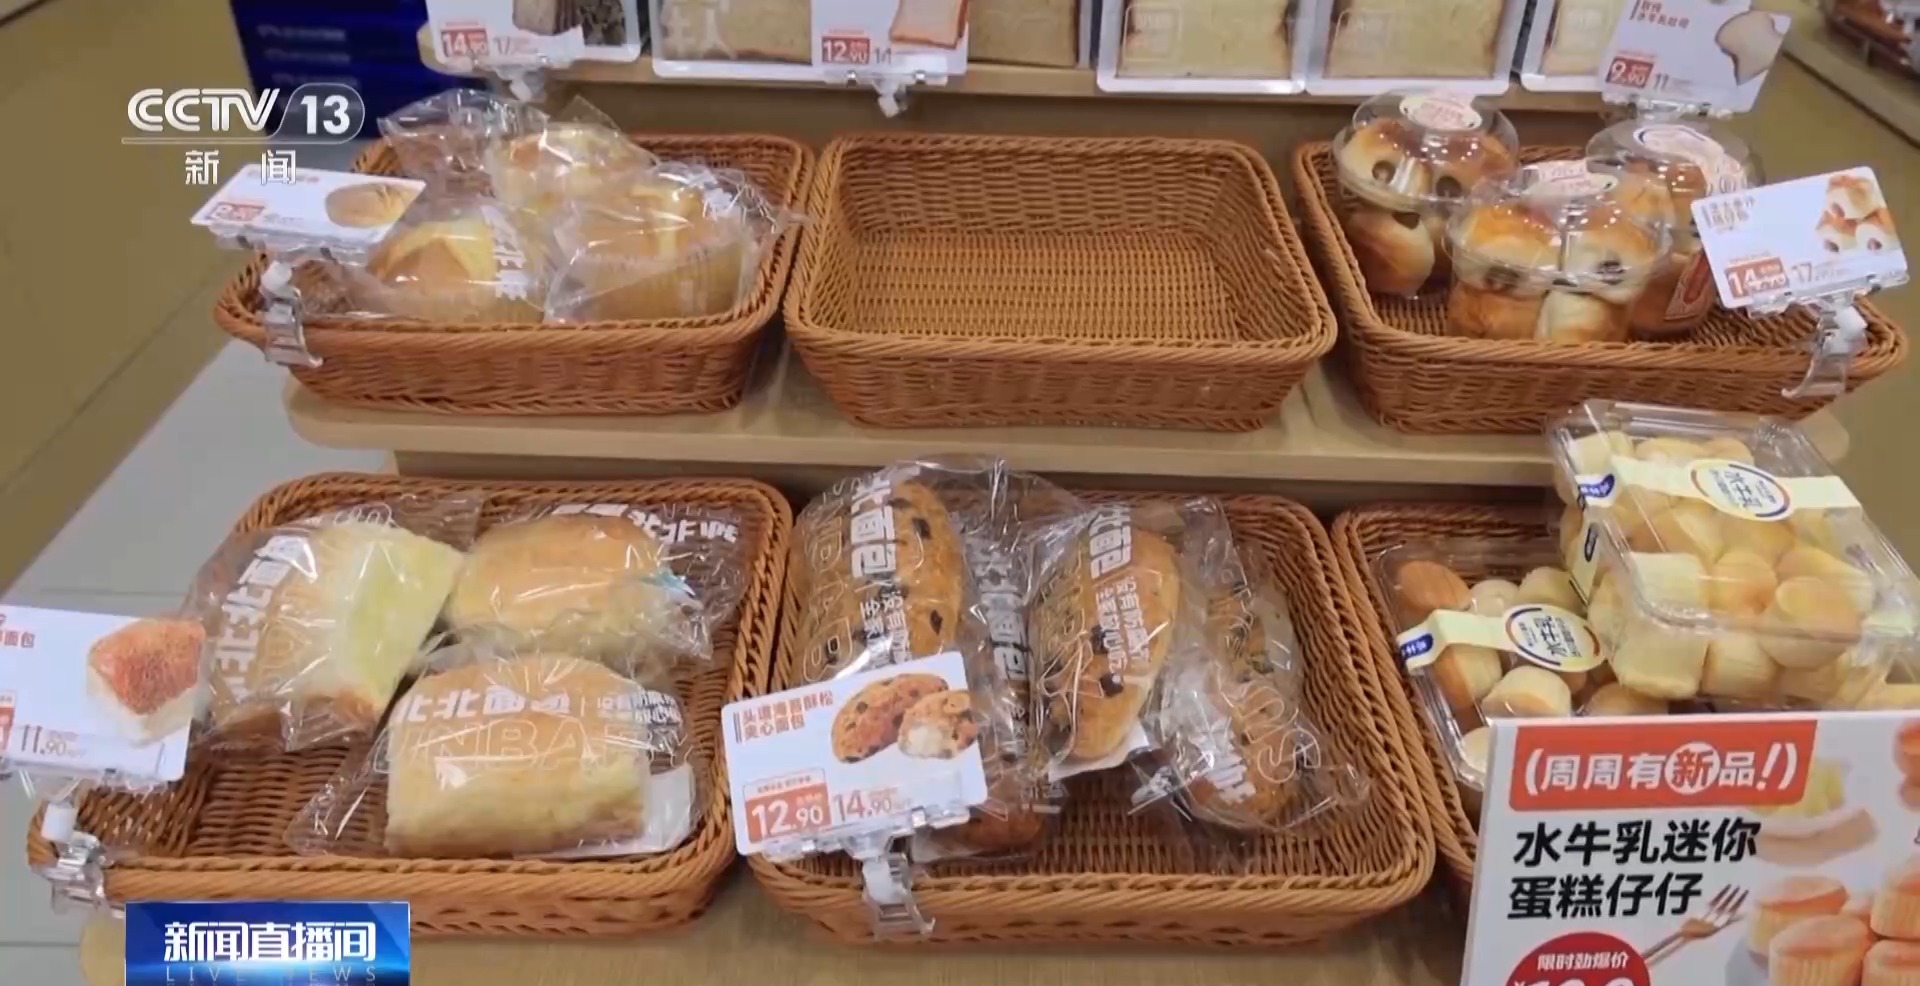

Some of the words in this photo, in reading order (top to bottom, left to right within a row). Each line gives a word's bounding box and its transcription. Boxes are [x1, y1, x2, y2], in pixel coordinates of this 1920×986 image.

[752, 799, 824, 839] 12.90
[834, 790, 893, 822] 14.90
[1513, 816, 1762, 867] 水牛乳迷你
[1507, 872, 1704, 919] 蛋糕仔仔
[1537, 950, 1629, 971] 限时劲爆价
